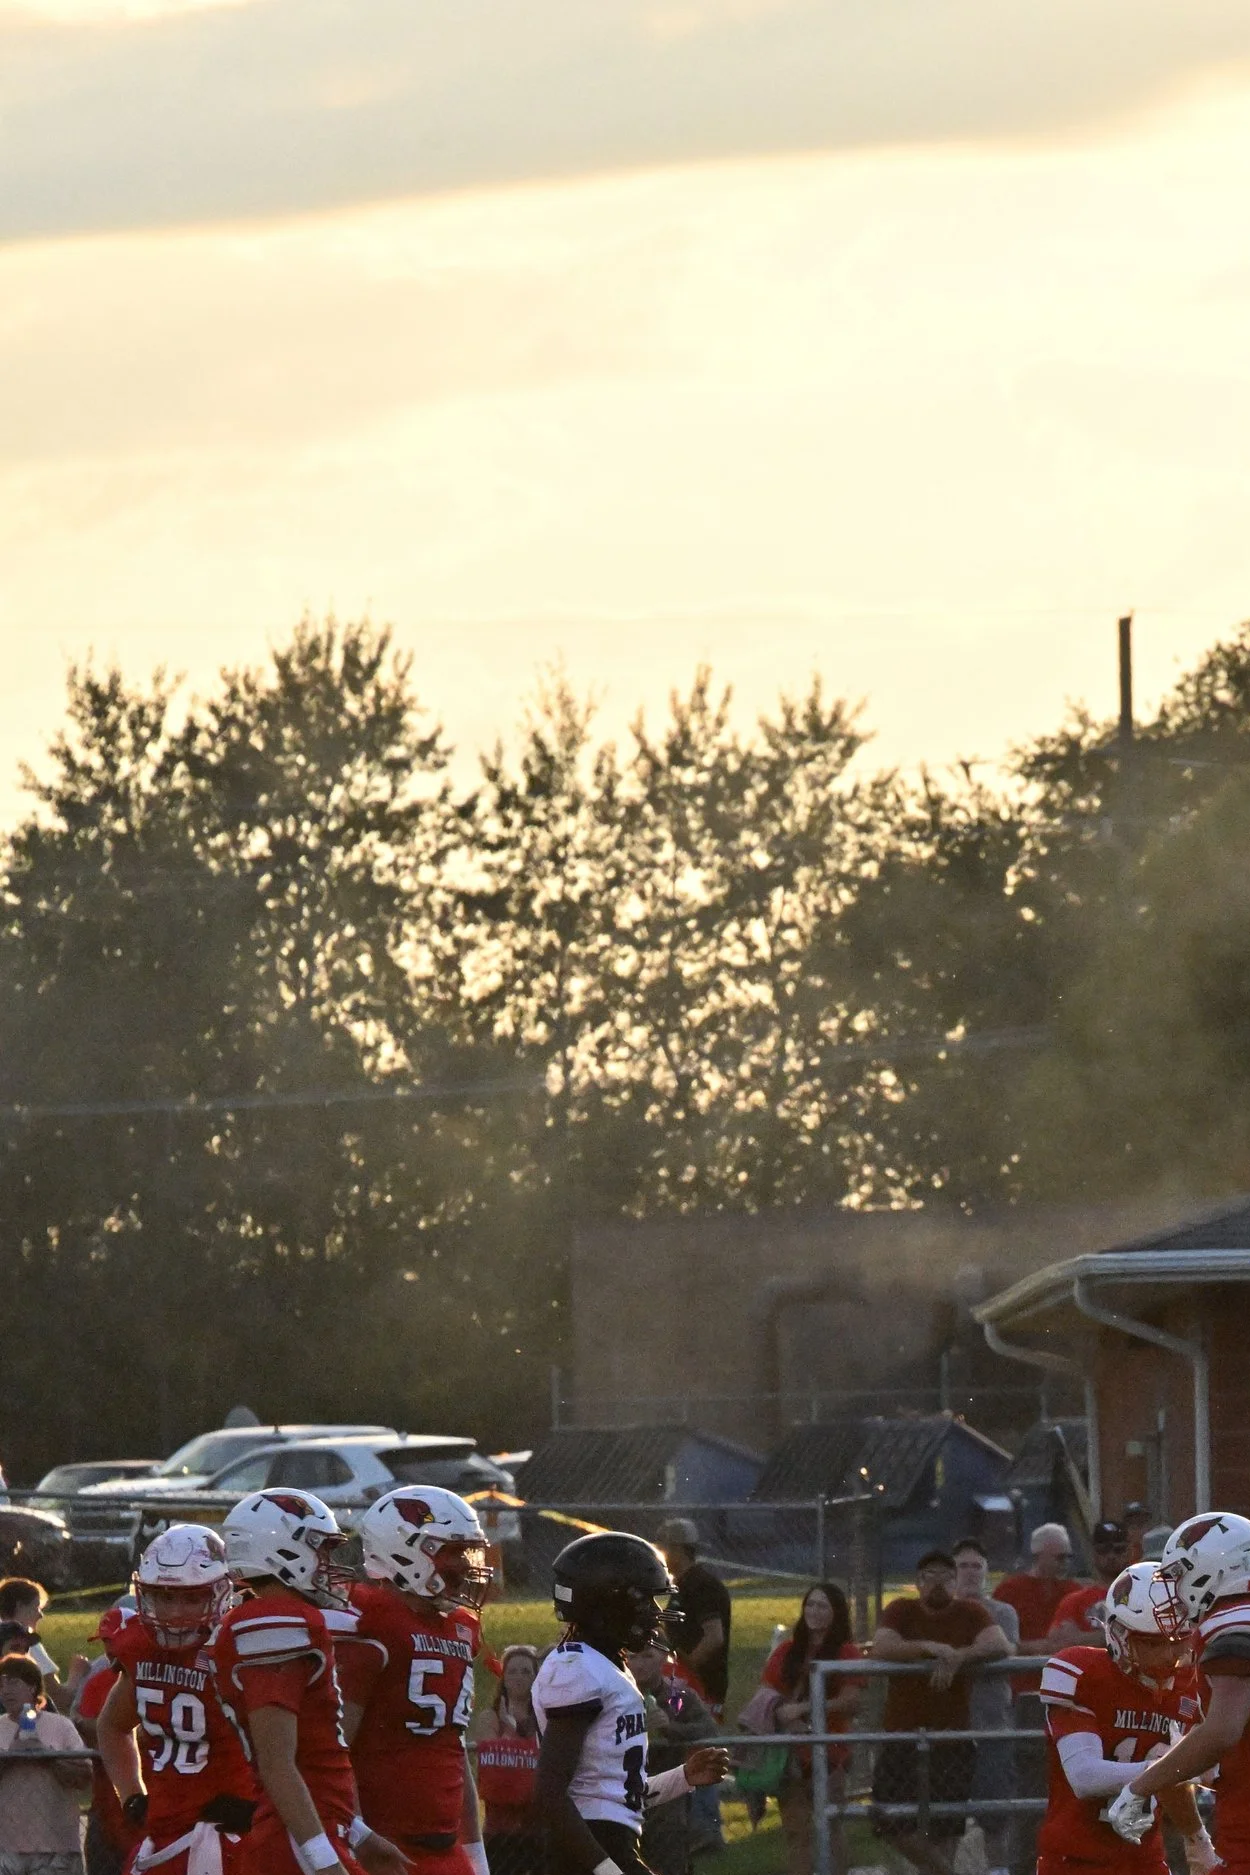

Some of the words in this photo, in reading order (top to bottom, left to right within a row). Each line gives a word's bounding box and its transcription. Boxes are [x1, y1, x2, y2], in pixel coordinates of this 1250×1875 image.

[411, 1633, 473, 1662] MILLINGTON
[136, 1661, 208, 1692] MILLINGTON
[136, 1686, 210, 1774] 58
